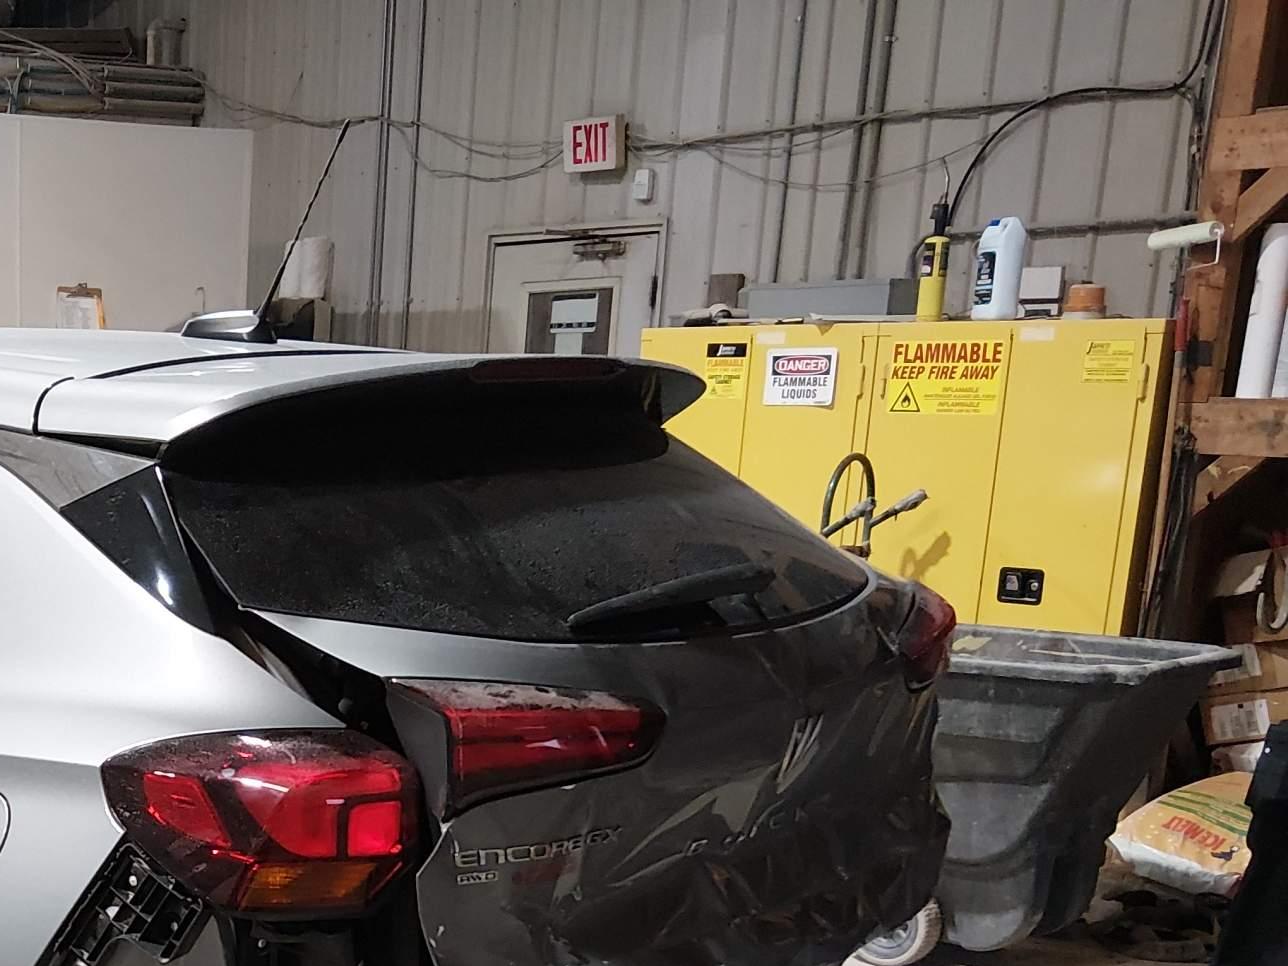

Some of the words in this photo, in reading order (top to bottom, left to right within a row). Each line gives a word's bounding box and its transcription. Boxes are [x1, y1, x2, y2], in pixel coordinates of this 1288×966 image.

[573, 122, 609, 165] EXIT
[893, 343, 1003, 364] FLAMMABLE
[778, 358, 826, 372] DANGER
[891, 365, 925, 380] KEEP
[927, 365, 958, 380] FIRE
[959, 365, 1000, 380] AWAY
[773, 376, 828, 387] FLAMMABLE
[781, 388, 817, 399] LIQUIDS
[455, 834, 584, 868] ENCORE
[586, 825, 623, 846] GX
[458, 872, 498, 884] AWD
